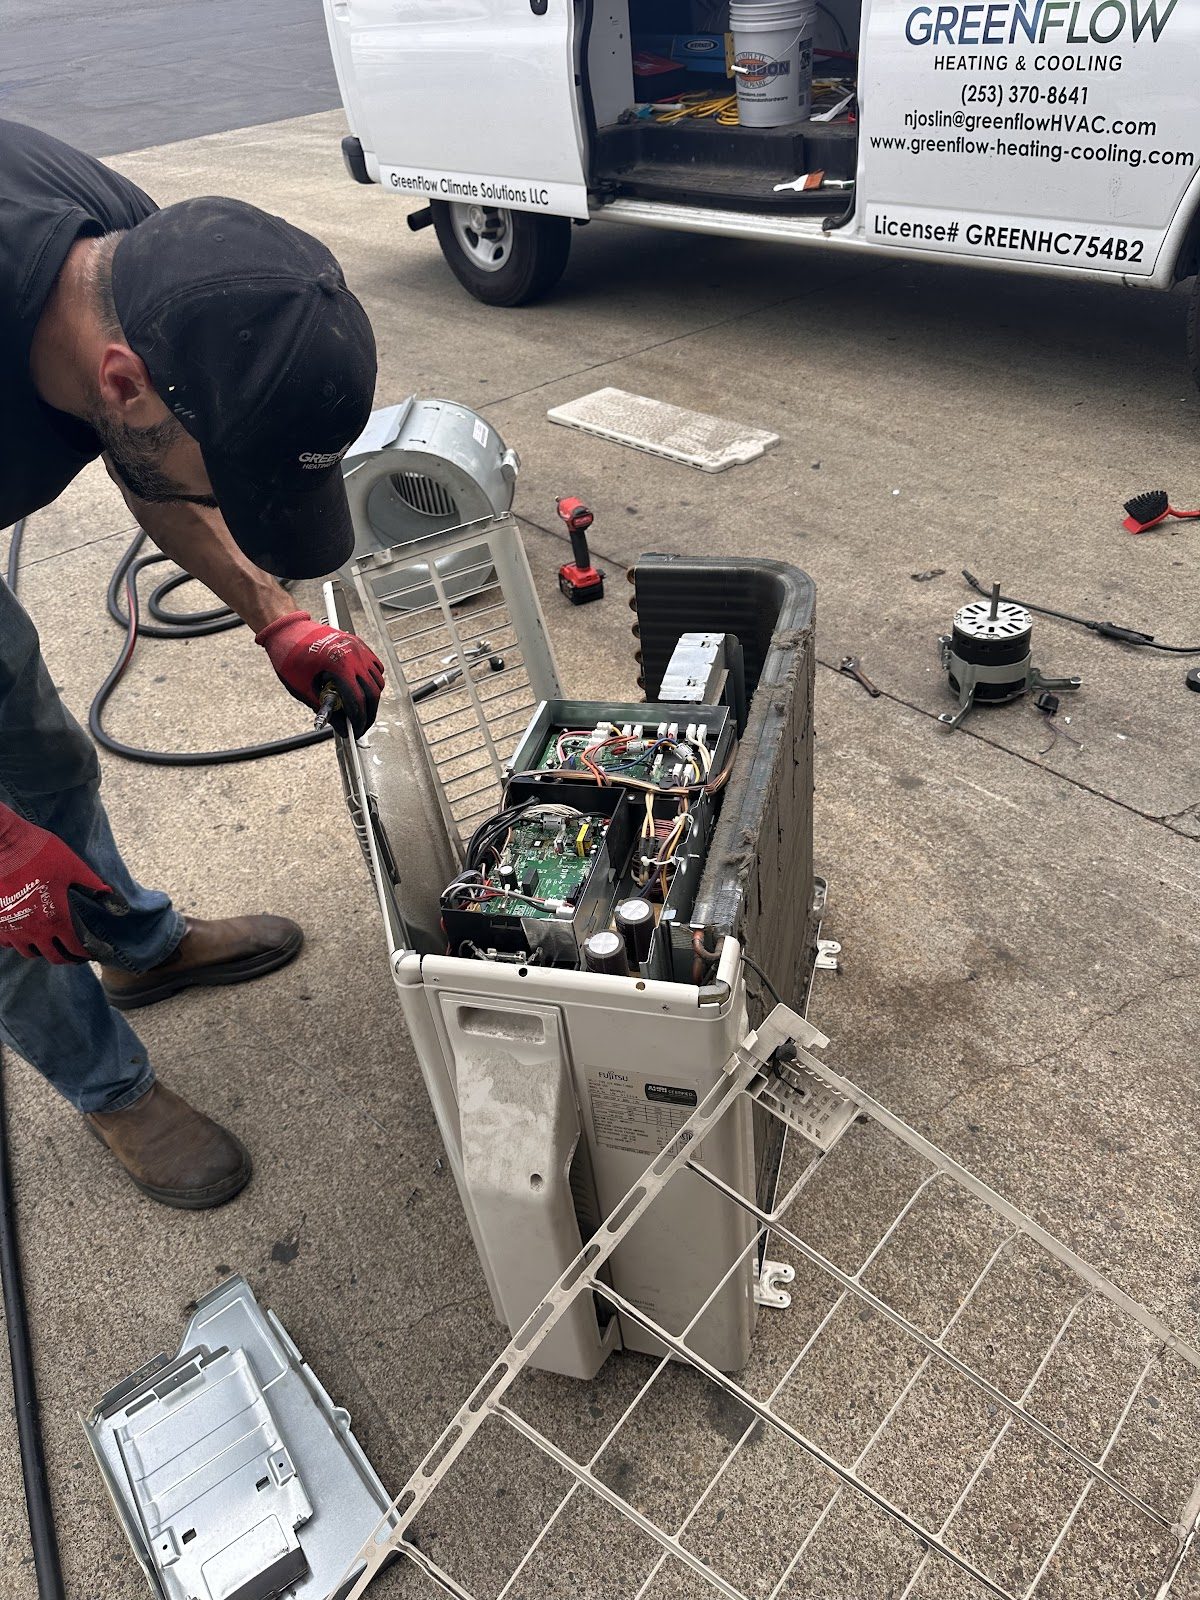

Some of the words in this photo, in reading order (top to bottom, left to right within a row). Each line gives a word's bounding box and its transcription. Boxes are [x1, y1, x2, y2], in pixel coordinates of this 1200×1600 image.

[905, 0, 1179, 45] GREENFLOW
[934, 56, 1008, 71] HEATING
[1015, 56, 1026, 71] &
[1034, 55, 1123, 72] COOLING
[961, 84, 1003, 106] (253)
[1009, 85, 1089, 105] 370-8641
[904, 110, 1157, 136] njoslin@greenflowHVAC.com
[870, 136, 1195, 167] www.greenflow-heating-cooling.com
[390, 173, 438, 192] GreenFlow
[440, 178, 478, 197] Climate
[480, 182, 527, 204] Solutions
[530, 188, 549, 206] LLC
[874, 215, 959, 243] License#
[966, 223, 1144, 263] GREENHC754B2
